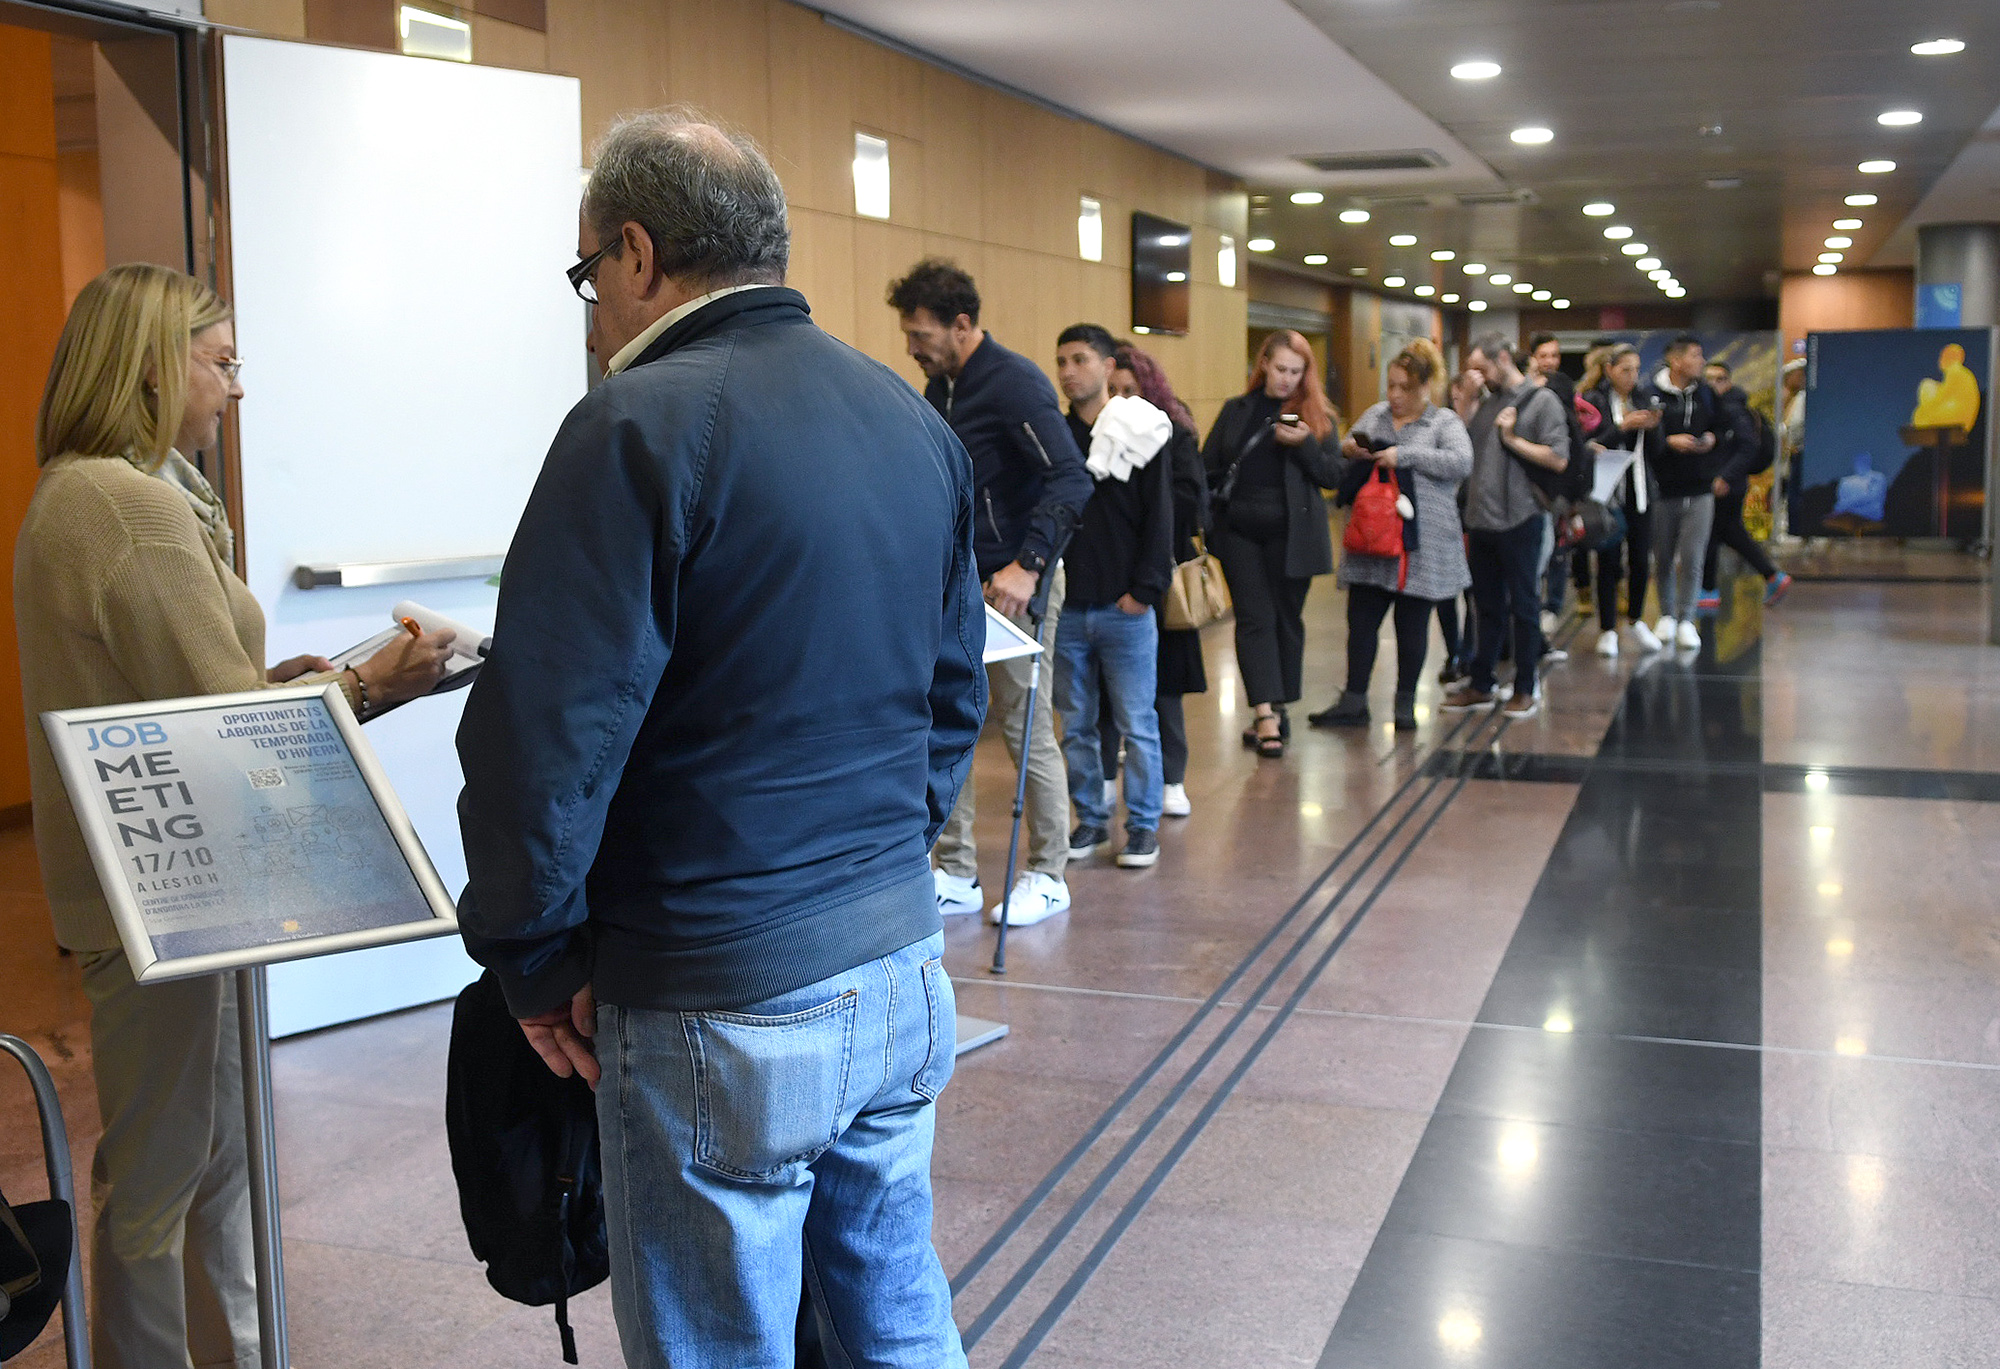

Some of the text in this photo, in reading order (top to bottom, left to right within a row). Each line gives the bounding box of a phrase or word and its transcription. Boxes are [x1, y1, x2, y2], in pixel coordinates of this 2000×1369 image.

[222, 706, 322, 725] OPORTUNITATS
[87, 722, 168, 751] JOB
[217, 719, 329, 739] LABORALS DE LA
[251, 732, 335, 749] TEMPORADA
[275, 744, 341, 760] D'HIVERN
[94, 750, 180, 782] ME
[105, 781, 194, 814] ETI
[117, 814, 204, 847] NG
[131, 847, 214, 875] 17/10
[137, 882, 147, 893] A
[152, 878, 182, 891] LES
[184, 874, 203, 886] 10
